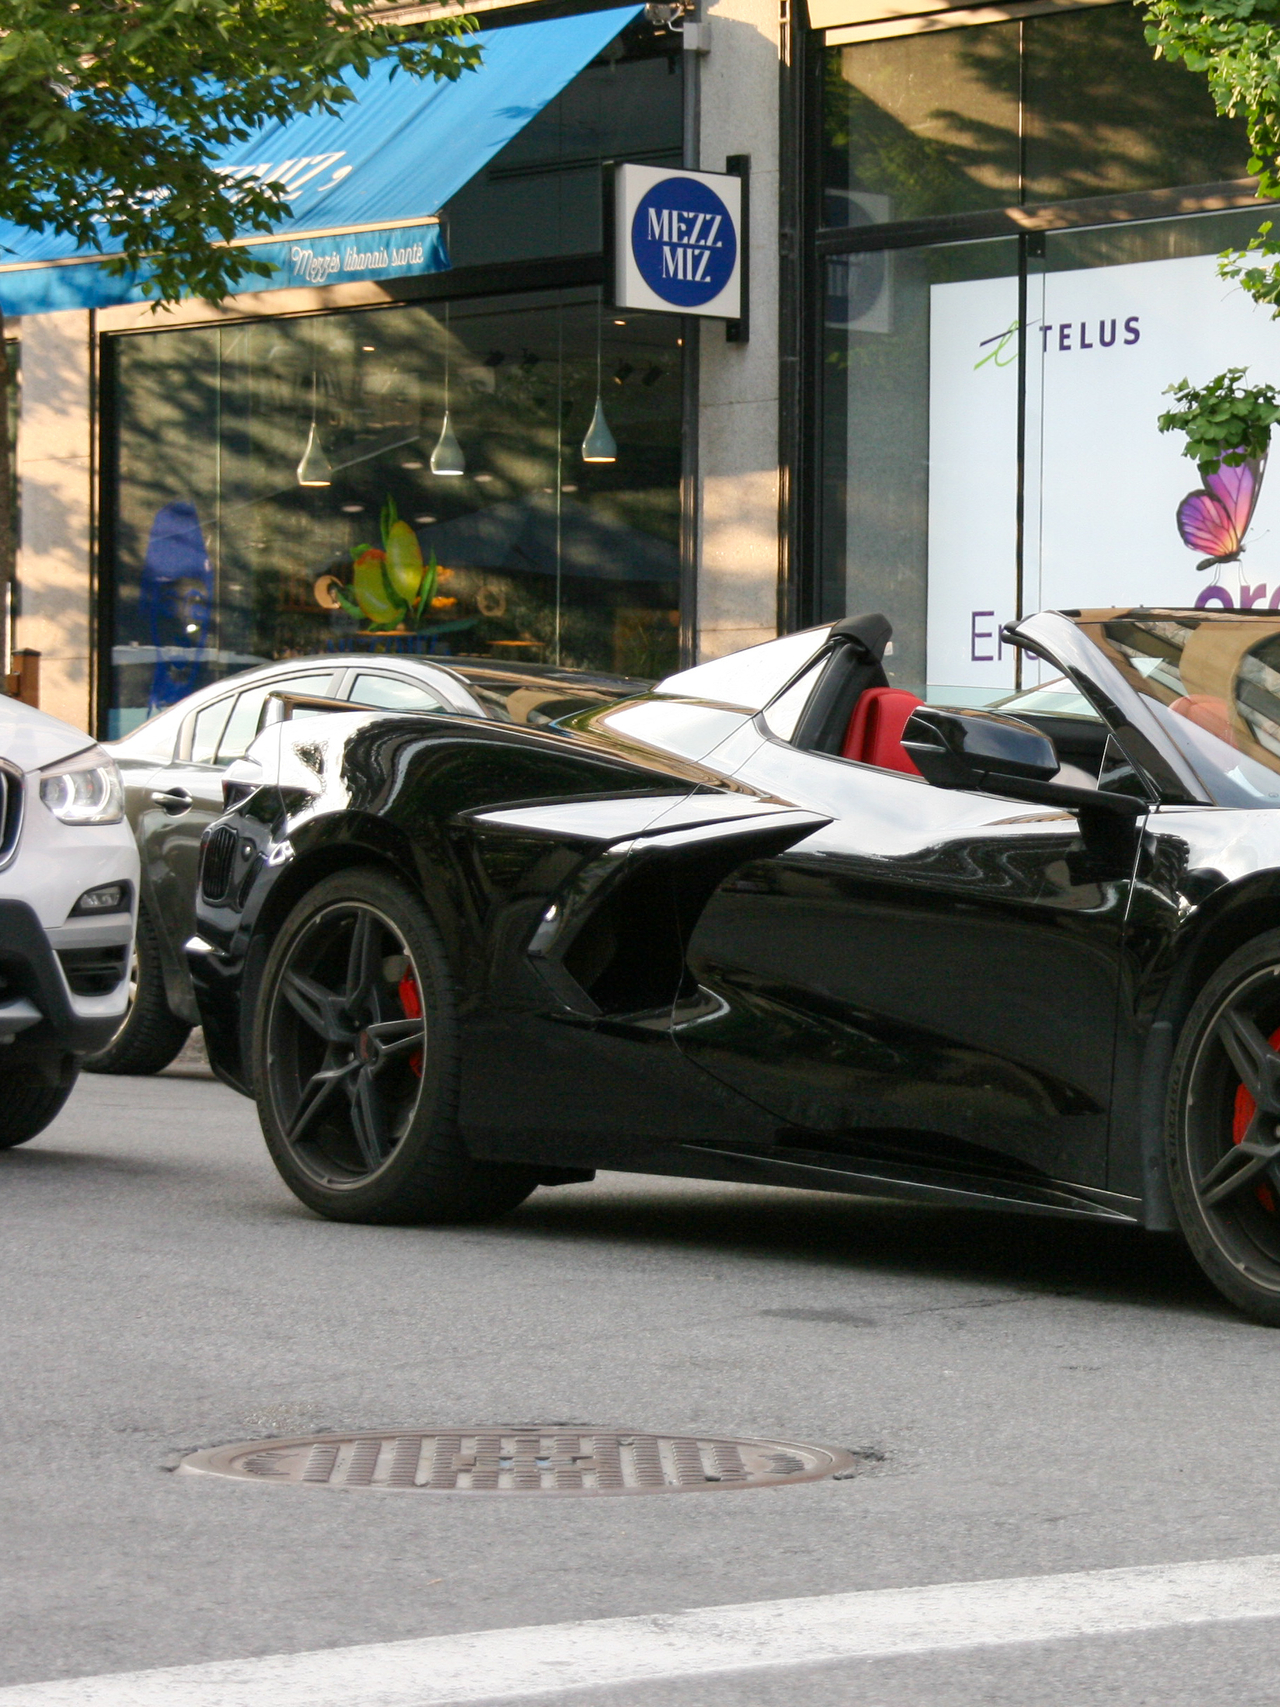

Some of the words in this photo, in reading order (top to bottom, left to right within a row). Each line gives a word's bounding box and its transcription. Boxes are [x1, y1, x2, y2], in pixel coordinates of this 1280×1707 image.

[648, 207, 723, 248] MEZZ
[343, 246, 389, 272] libanais
[391, 242, 424, 266] santé
[662, 245, 711, 282] MIZ
[1039, 316, 1141, 353] TELUS
